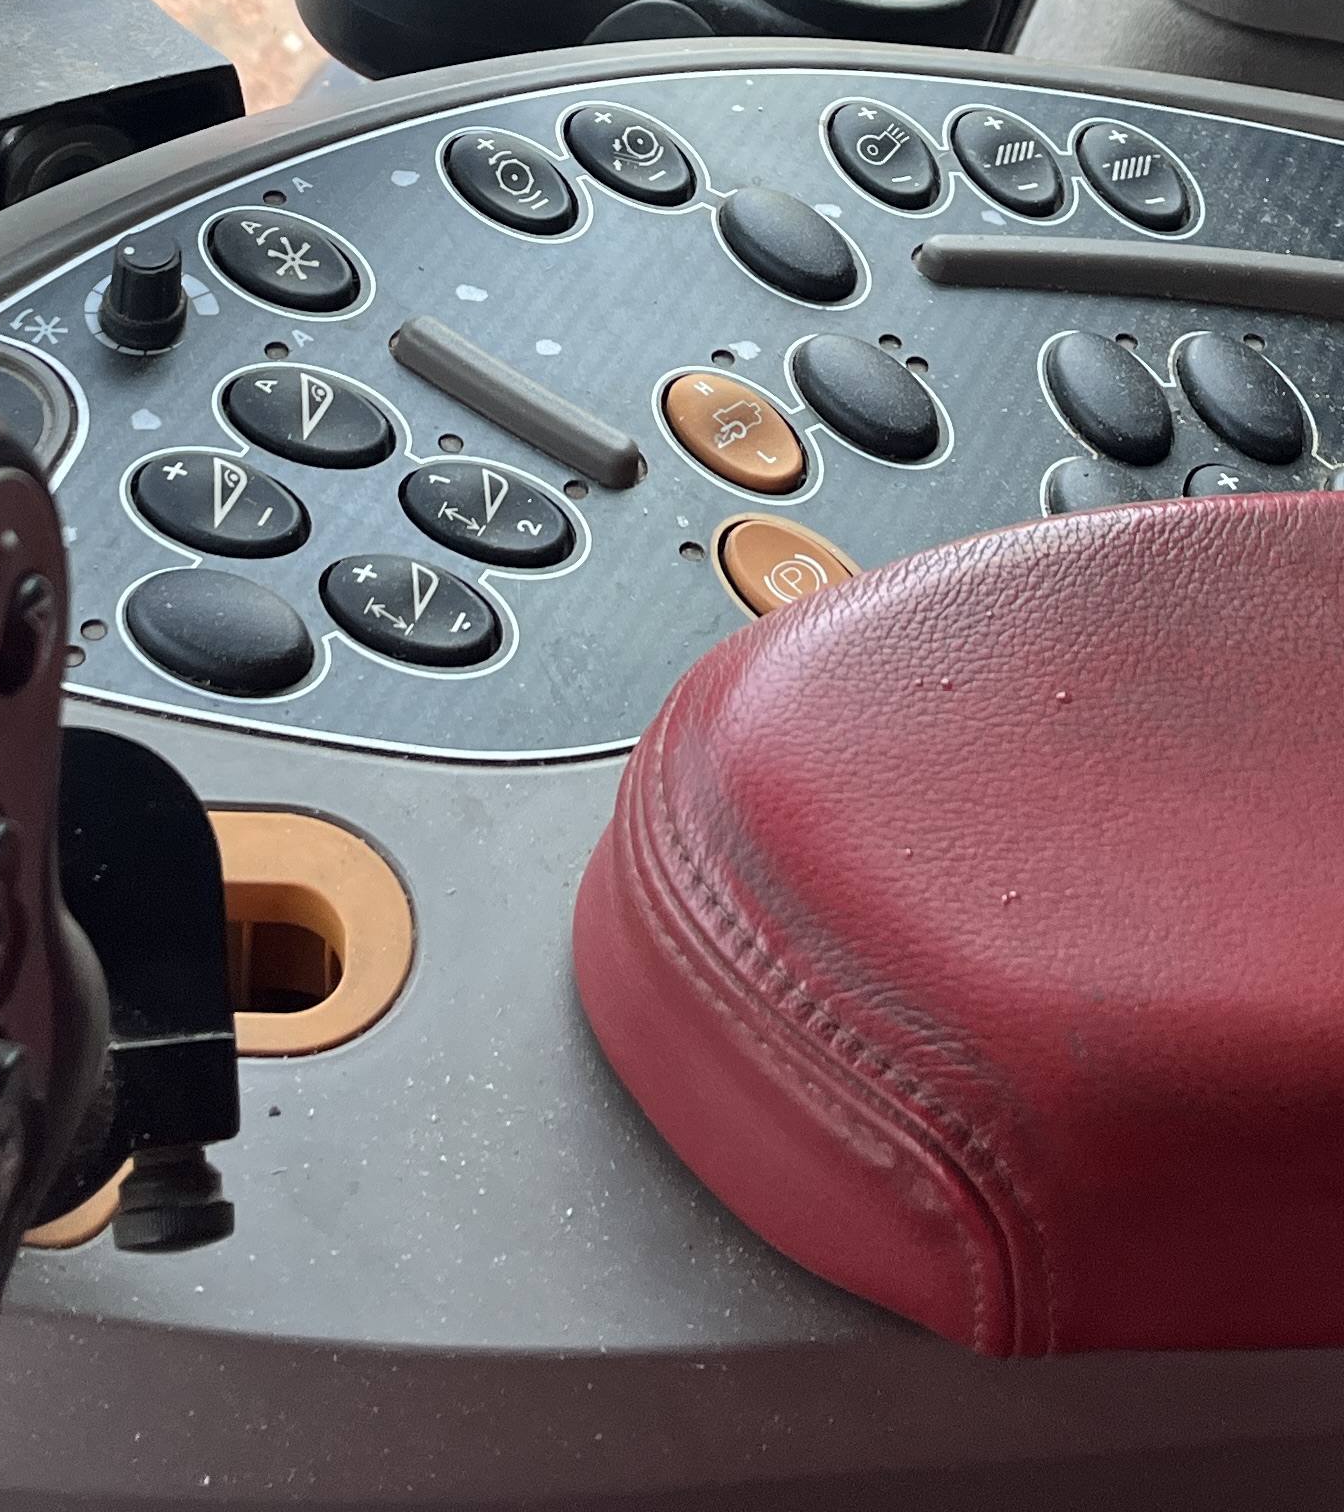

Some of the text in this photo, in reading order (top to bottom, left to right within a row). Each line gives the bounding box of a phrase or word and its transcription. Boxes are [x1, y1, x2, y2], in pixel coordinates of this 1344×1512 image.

[292, 177, 313, 193] A
[241, 220, 262, 234] A
[291, 329, 314, 347] A
[254, 379, 278, 393] A
[694, 381, 714, 396] H
[757, 450, 777, 463] L
[428, 474, 451, 484] 1
[516, 519, 543, 536] 2
[779, 566, 802, 594] P
